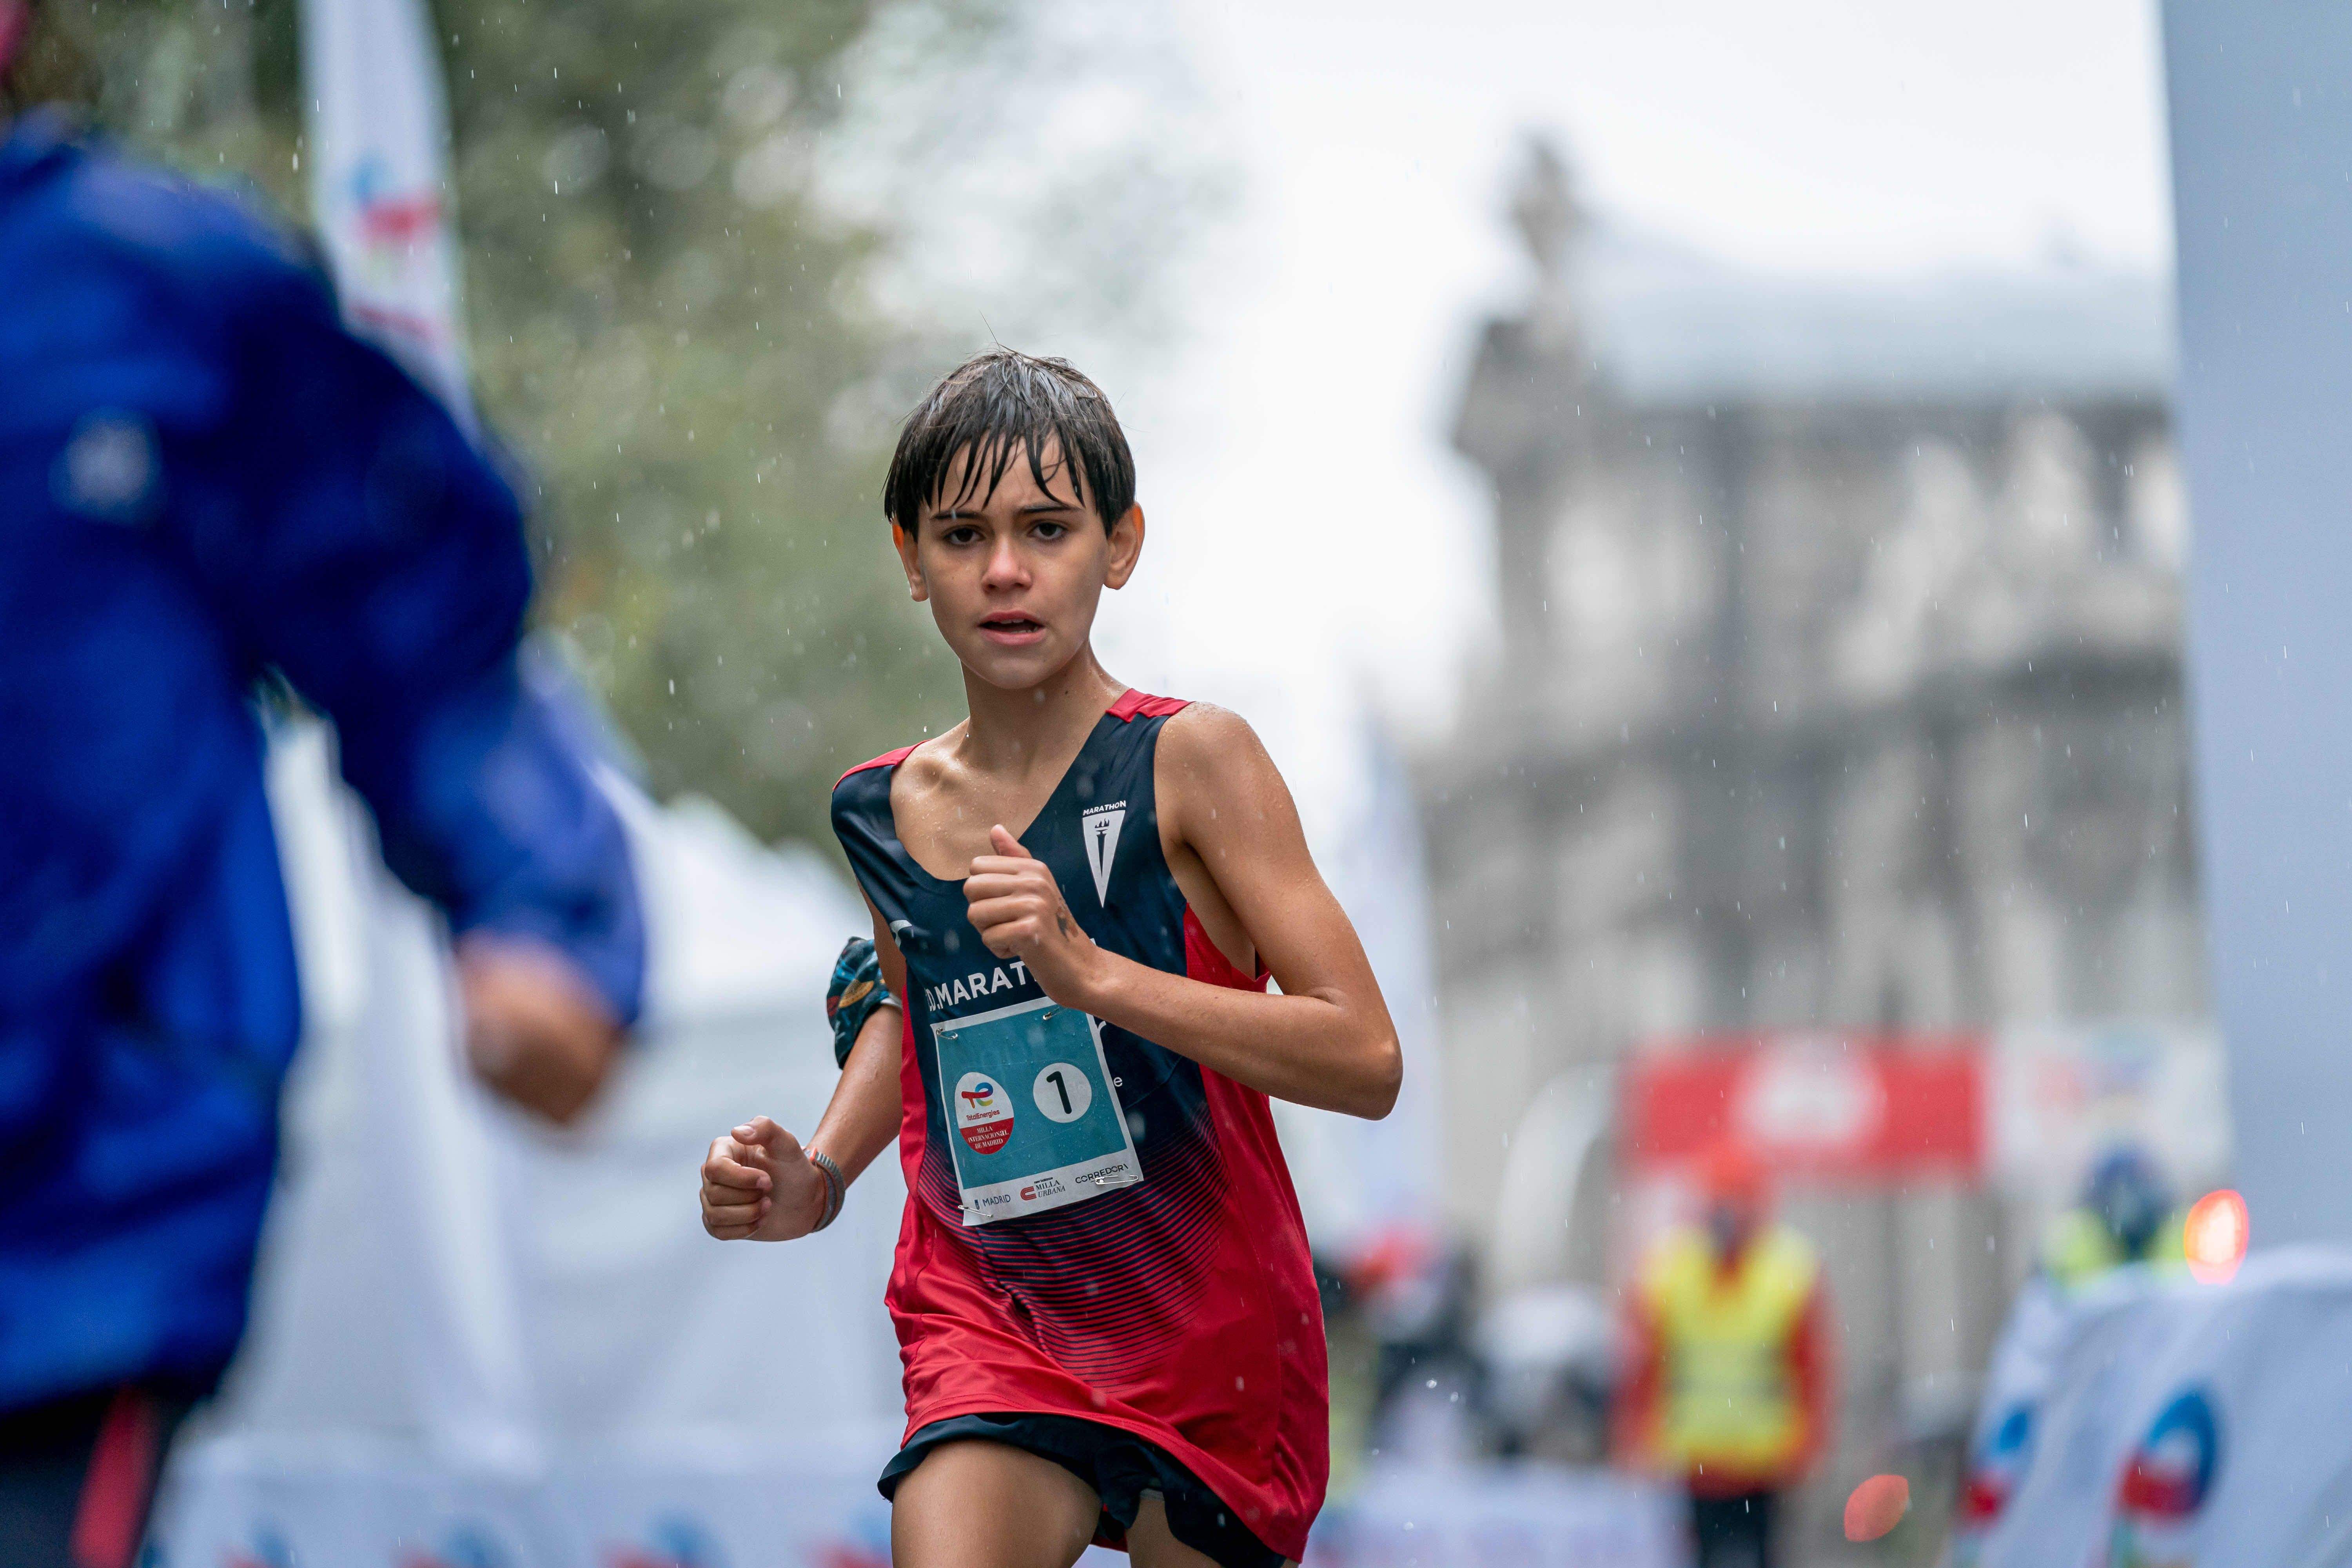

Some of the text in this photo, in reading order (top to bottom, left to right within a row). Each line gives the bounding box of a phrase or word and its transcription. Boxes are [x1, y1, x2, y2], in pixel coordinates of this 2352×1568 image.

[1083, 800, 1126, 816] MARATHON
[1046, 1071, 1072, 1114] 1
[966, 1109, 1000, 1122] TotalEnergies
[977, 1125, 993, 1134] MILLA
[982, 1138, 1003, 1148] MADRID
[1035, 1180, 1060, 1191] MILLA
[1038, 1185, 1066, 1198] URBANA
[982, 1194, 1011, 1207] MADRID
